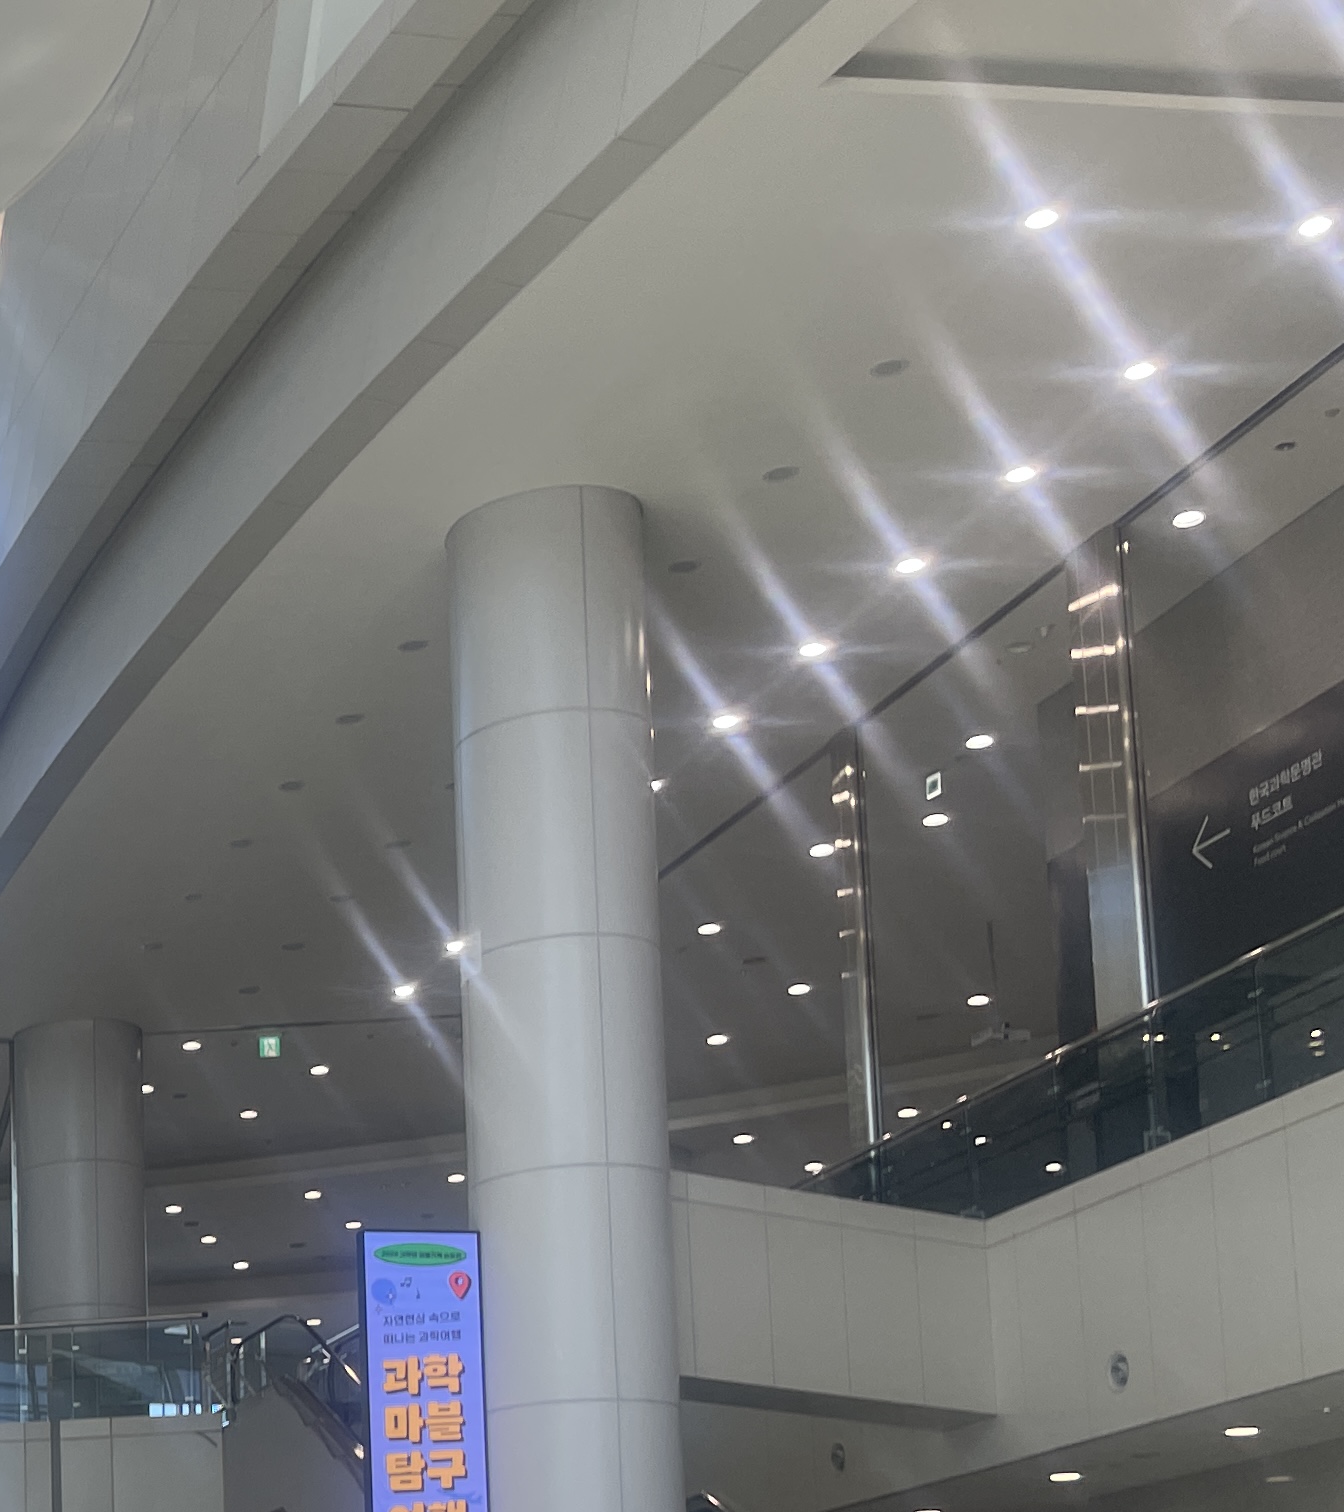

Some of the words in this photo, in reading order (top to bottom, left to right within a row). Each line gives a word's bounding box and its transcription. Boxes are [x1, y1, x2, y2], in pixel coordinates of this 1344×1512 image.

[1251, 793, 1293, 831] 푸드코트
[381, 1354, 465, 1395] 과학
[384, 1401, 466, 1443] 마블
[384, 1449, 468, 1493] 탐구
